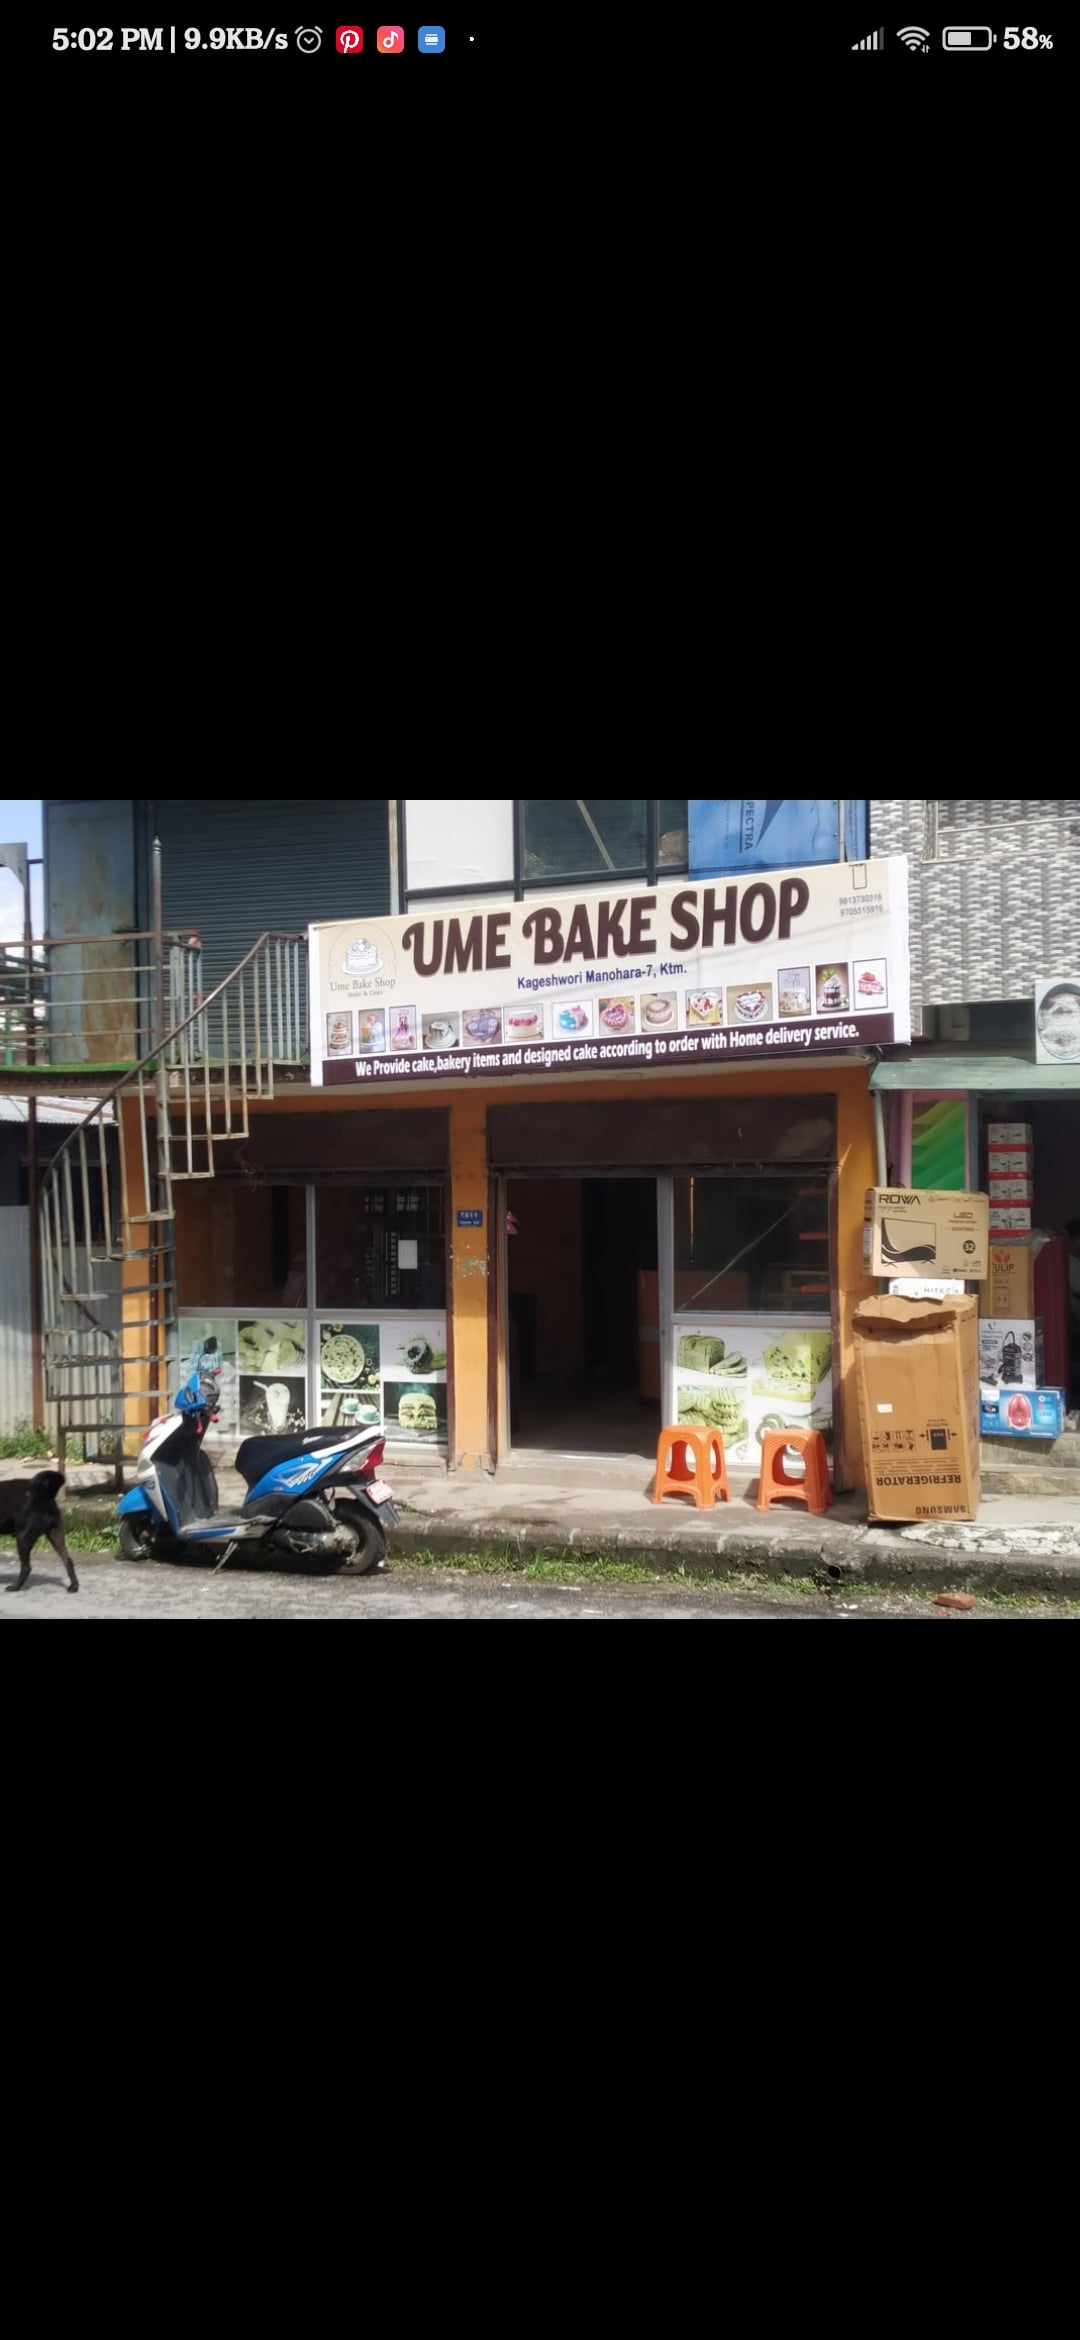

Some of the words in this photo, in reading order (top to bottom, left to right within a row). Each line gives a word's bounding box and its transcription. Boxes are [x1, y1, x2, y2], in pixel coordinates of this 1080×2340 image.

[745, 800, 754, 851] PECTRA
[402, 913, 511, 976] UME
[522, 895, 657, 965] BAKE
[670, 877, 810, 951] SHOP
[330, 981, 350, 992] Ume
[352, 979, 373, 990] Bake
[374, 977, 396, 989] Shop
[517, 972, 583, 991] Kageshwori
[585, 964, 657, 984] Manohara-7,
[660, 962, 688, 976] Ktm.
[355, 1061, 372, 1077] We
[373, 1058, 410, 1075] Provide
[473, 1052, 501, 1069] items
[502, 1049, 522, 1066] and
[523, 1045, 571, 1068] designed
[573, 1043, 598, 1061] cake
[599, 1039, 652, 1060] according
[655, 1039, 667, 1054] to
[669, 1034, 700, 1053] order
[701, 1033, 727, 1050] with
[729, 1031, 763, 1049] Home
[764, 1026, 812, 1047] delivery
[814, 1022, 860, 1041] service.
[878, 1194, 921, 1205] ROWA
[876, 1474, 961, 1486] REFRIGERATOR
[915, 1505, 966, 1515] SAMSUNG
